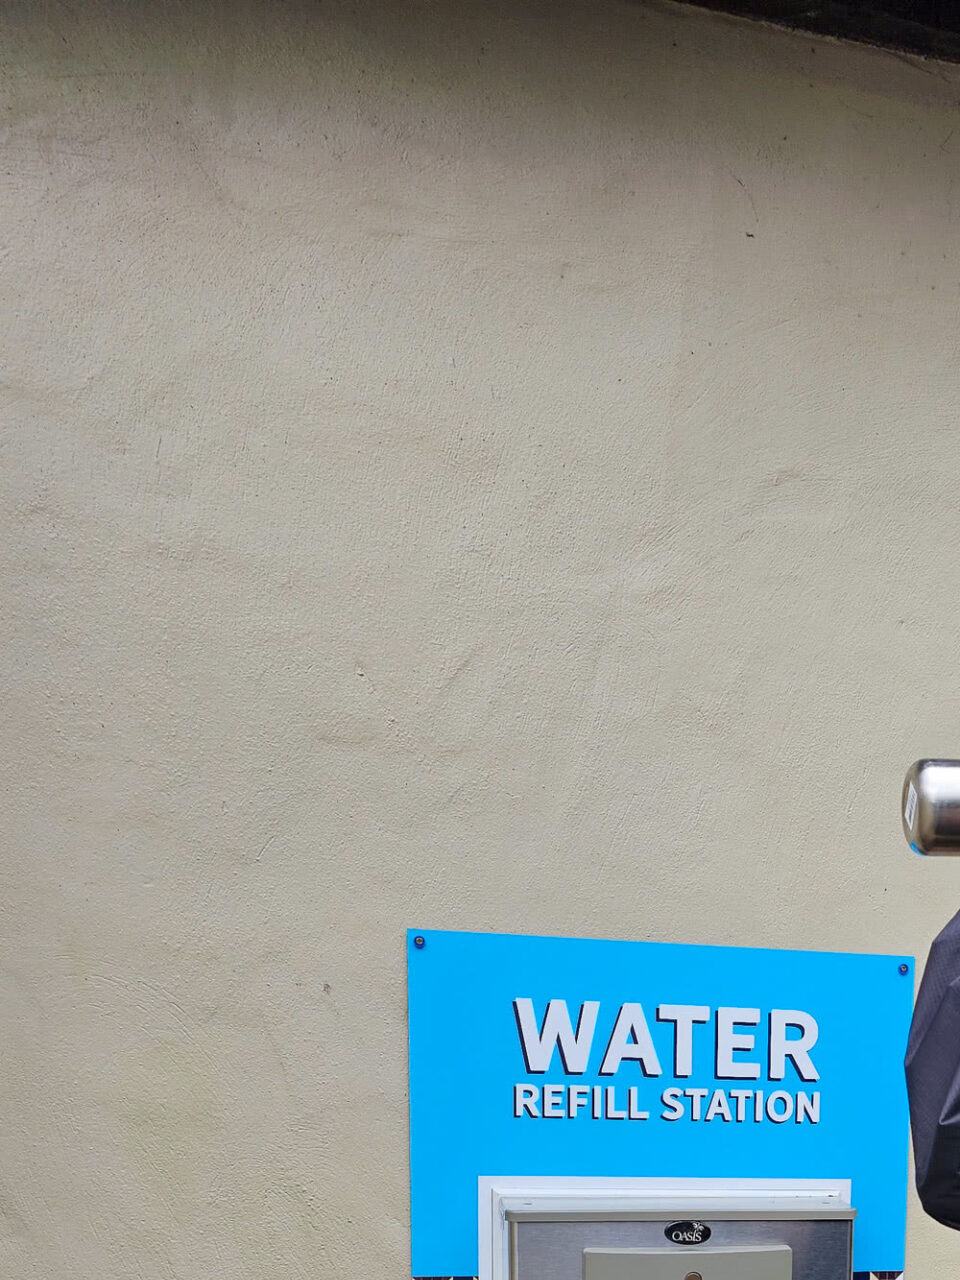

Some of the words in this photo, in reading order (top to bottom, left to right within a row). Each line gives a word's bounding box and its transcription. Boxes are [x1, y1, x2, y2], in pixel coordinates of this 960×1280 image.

[512, 997, 820, 1082] WATER
[513, 1083, 650, 1120] REFILL
[660, 1087, 820, 1124] STATION
[672, 1229, 702, 1242] OASIS
